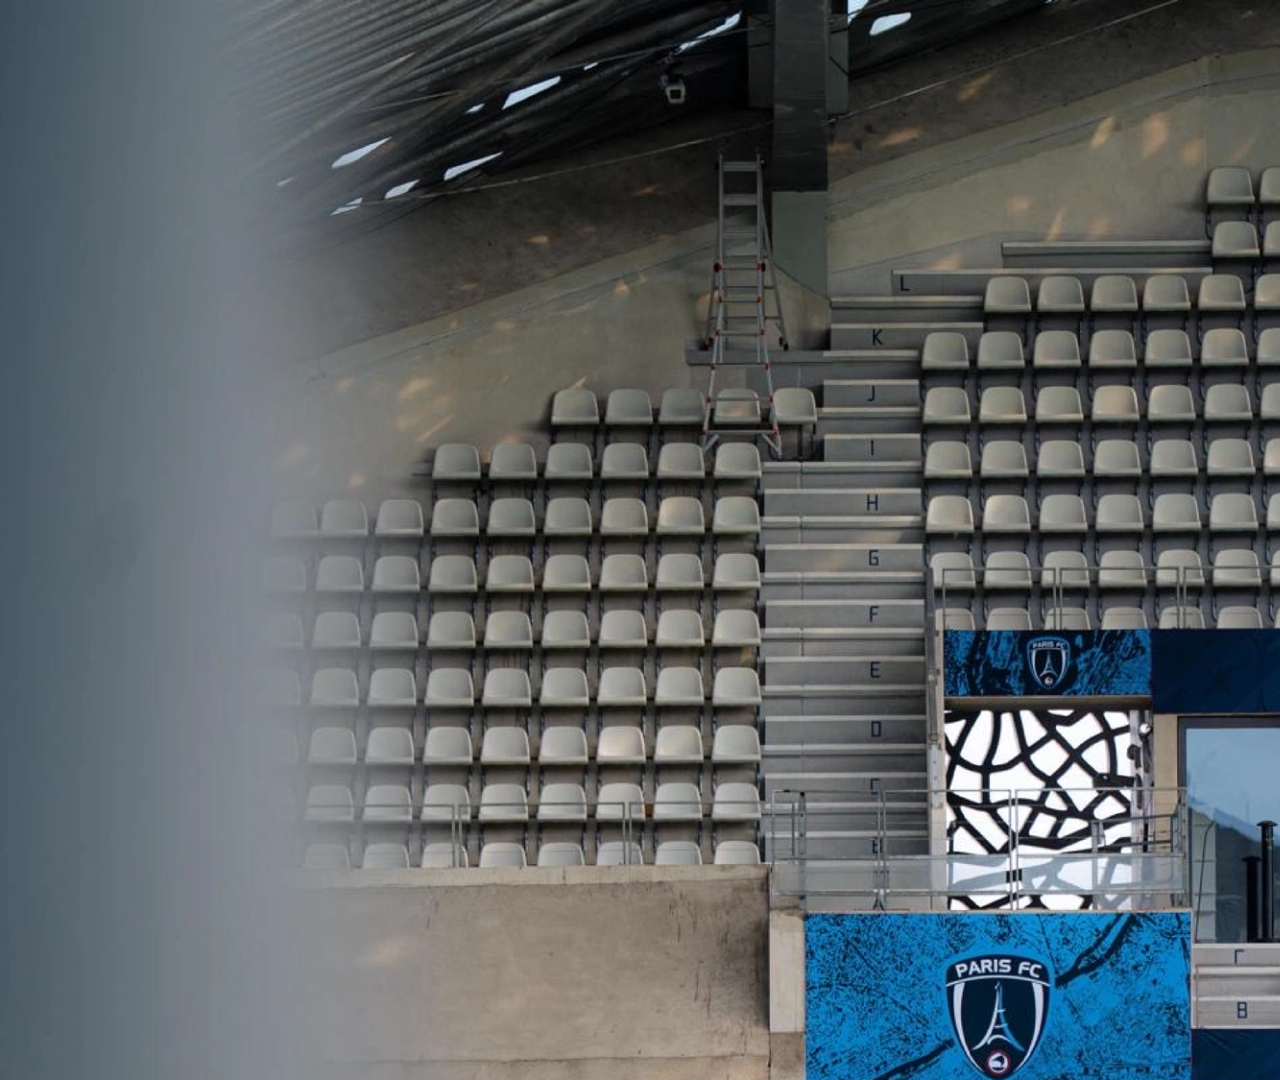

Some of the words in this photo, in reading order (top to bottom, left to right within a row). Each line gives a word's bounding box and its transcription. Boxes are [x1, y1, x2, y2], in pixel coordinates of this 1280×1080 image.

[899, 275, 910, 292] L
[871, 328, 883, 346] K
[867, 385, 876, 402] J
[866, 494, 879, 511] H
[868, 549, 879, 566] G
[869, 605, 879, 622] F
[870, 661, 881, 678] E
[955, 959, 1012, 978] PARIS
[1018, 961, 1042, 978] FC
[1237, 1001, 1248, 1019] B
